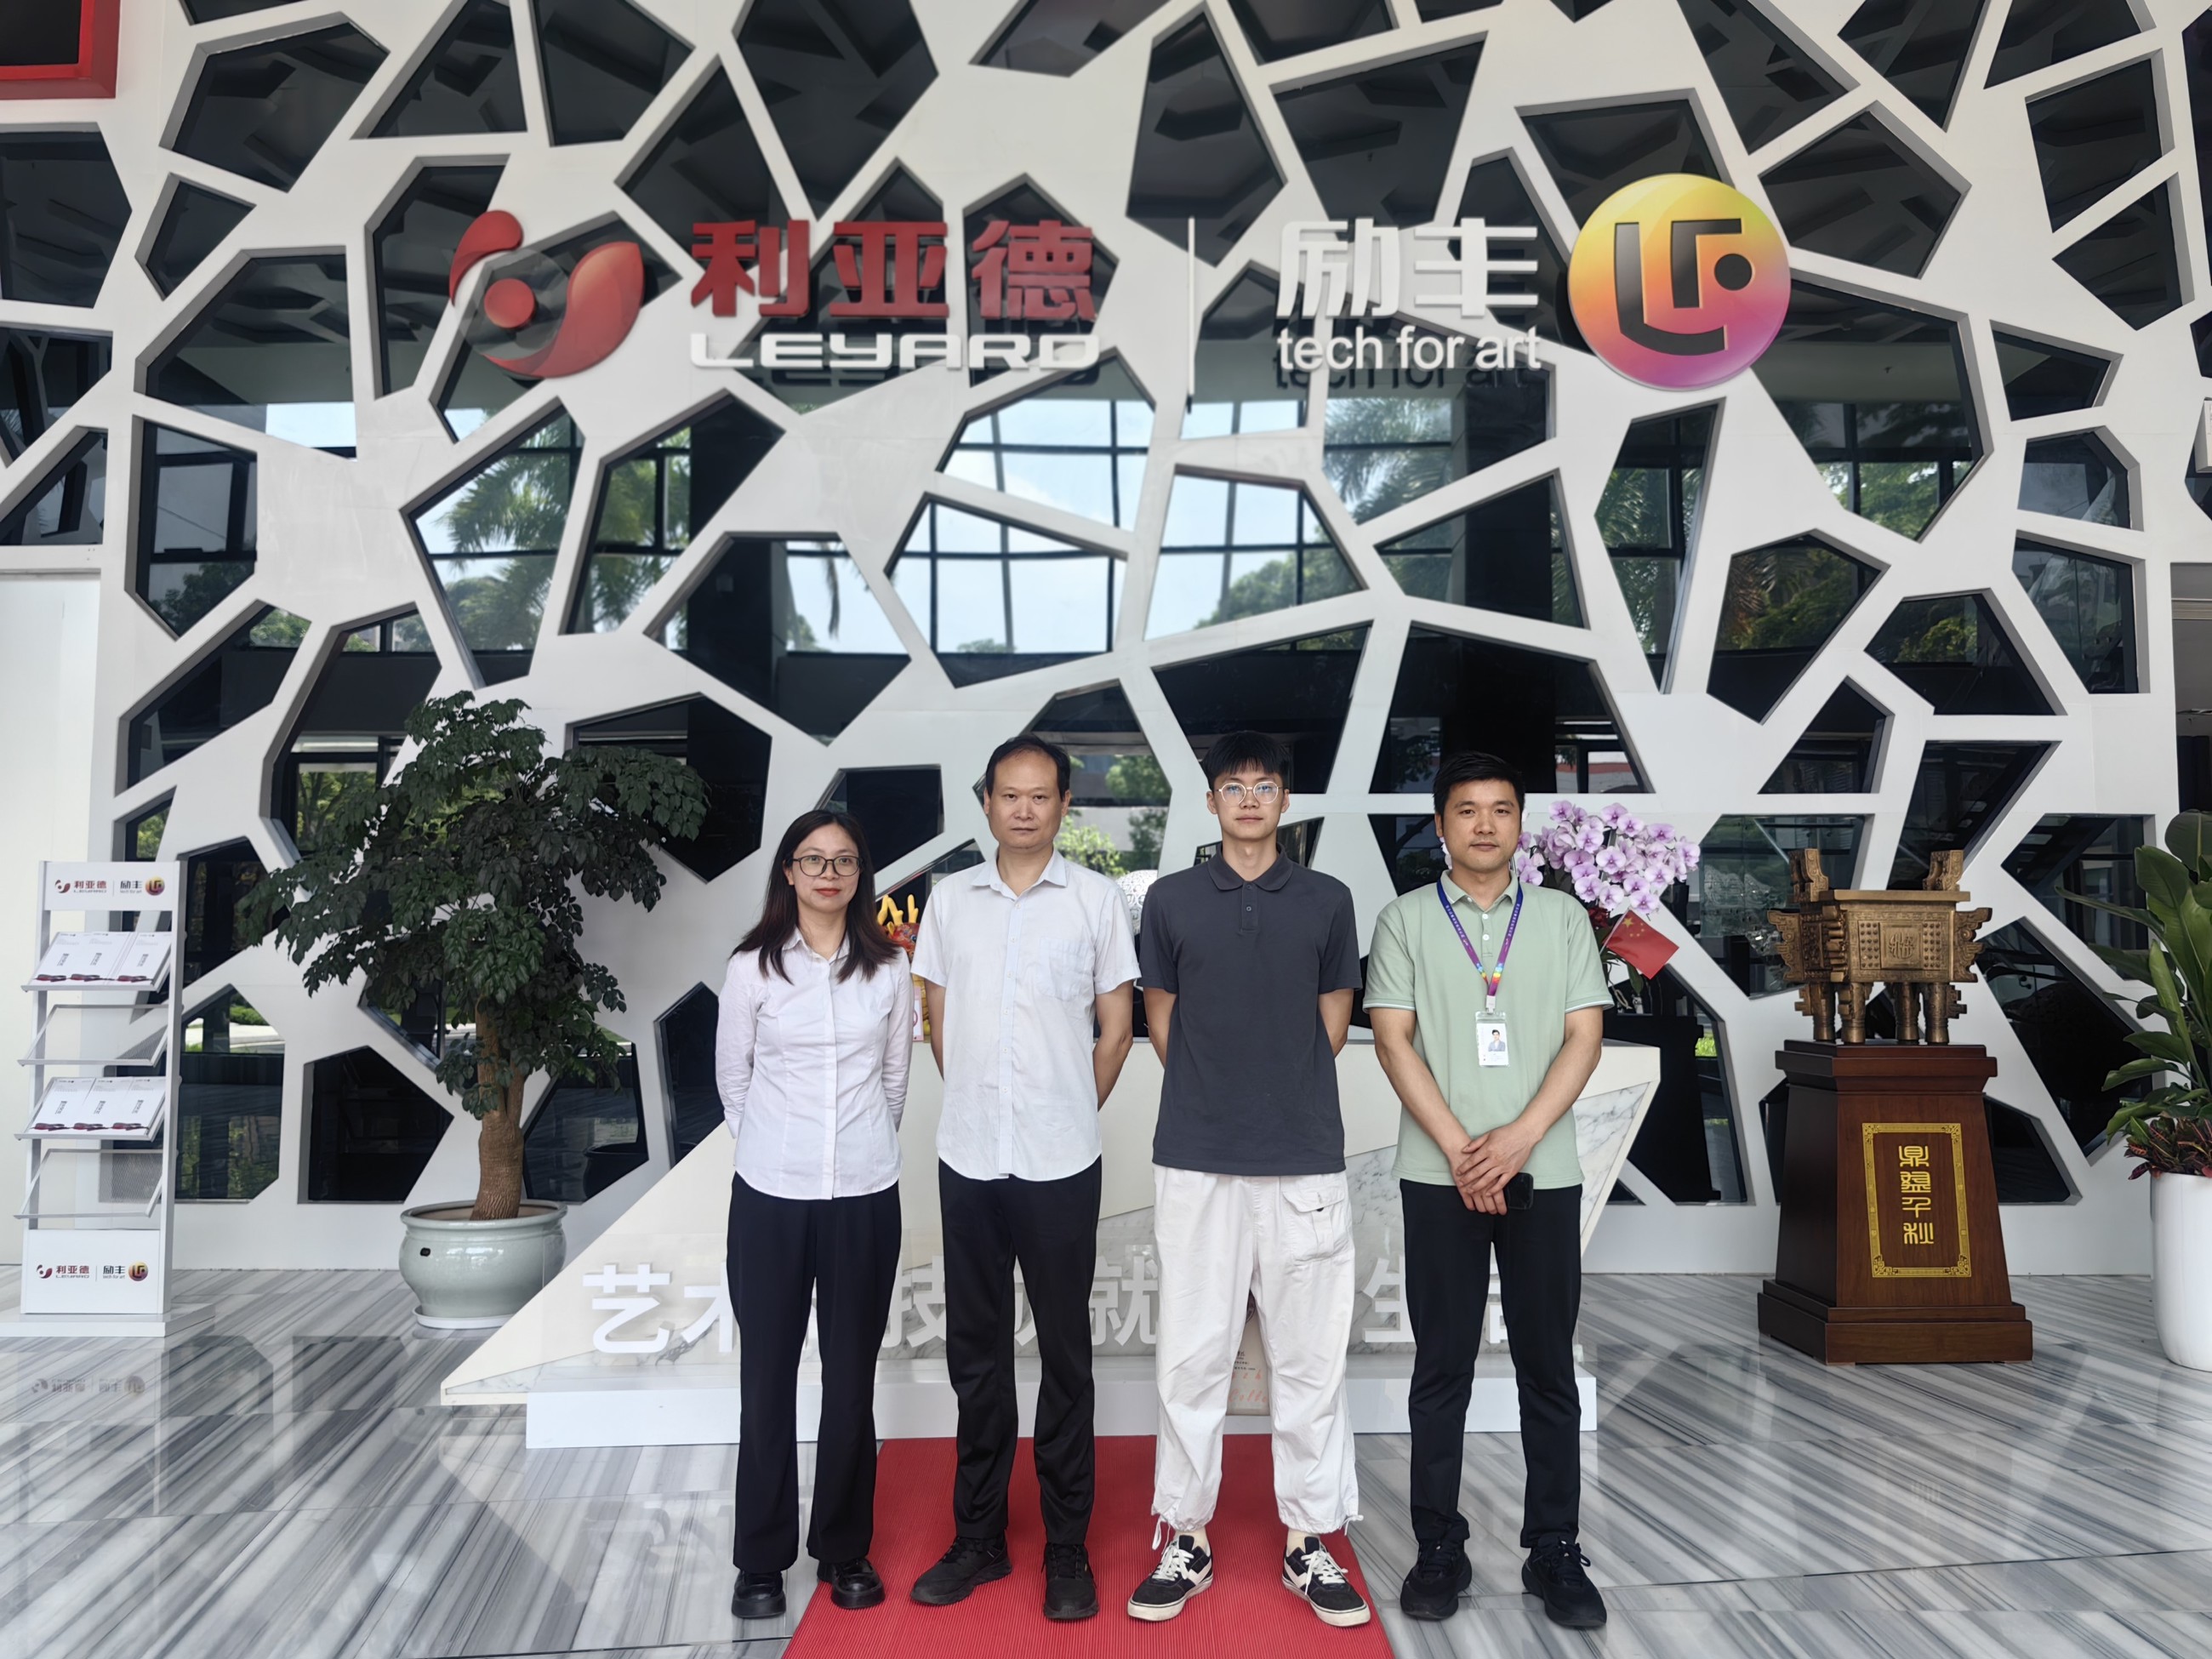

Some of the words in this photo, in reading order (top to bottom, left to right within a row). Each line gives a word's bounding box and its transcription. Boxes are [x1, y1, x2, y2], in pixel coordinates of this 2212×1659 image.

[690, 219, 1097, 320] 利亚德
[1276, 218, 1538, 317] 励丰
[690, 334, 1100, 370] LEYARD
[1279, 326, 1383, 370] tech
[1396, 325, 1465, 369] for
[1474, 325, 1542, 371] art
[74, 881, 106, 889] 利亚德
[55, 1265, 89, 1274] 利亚德
[103, 1265, 125, 1274] 励丰
